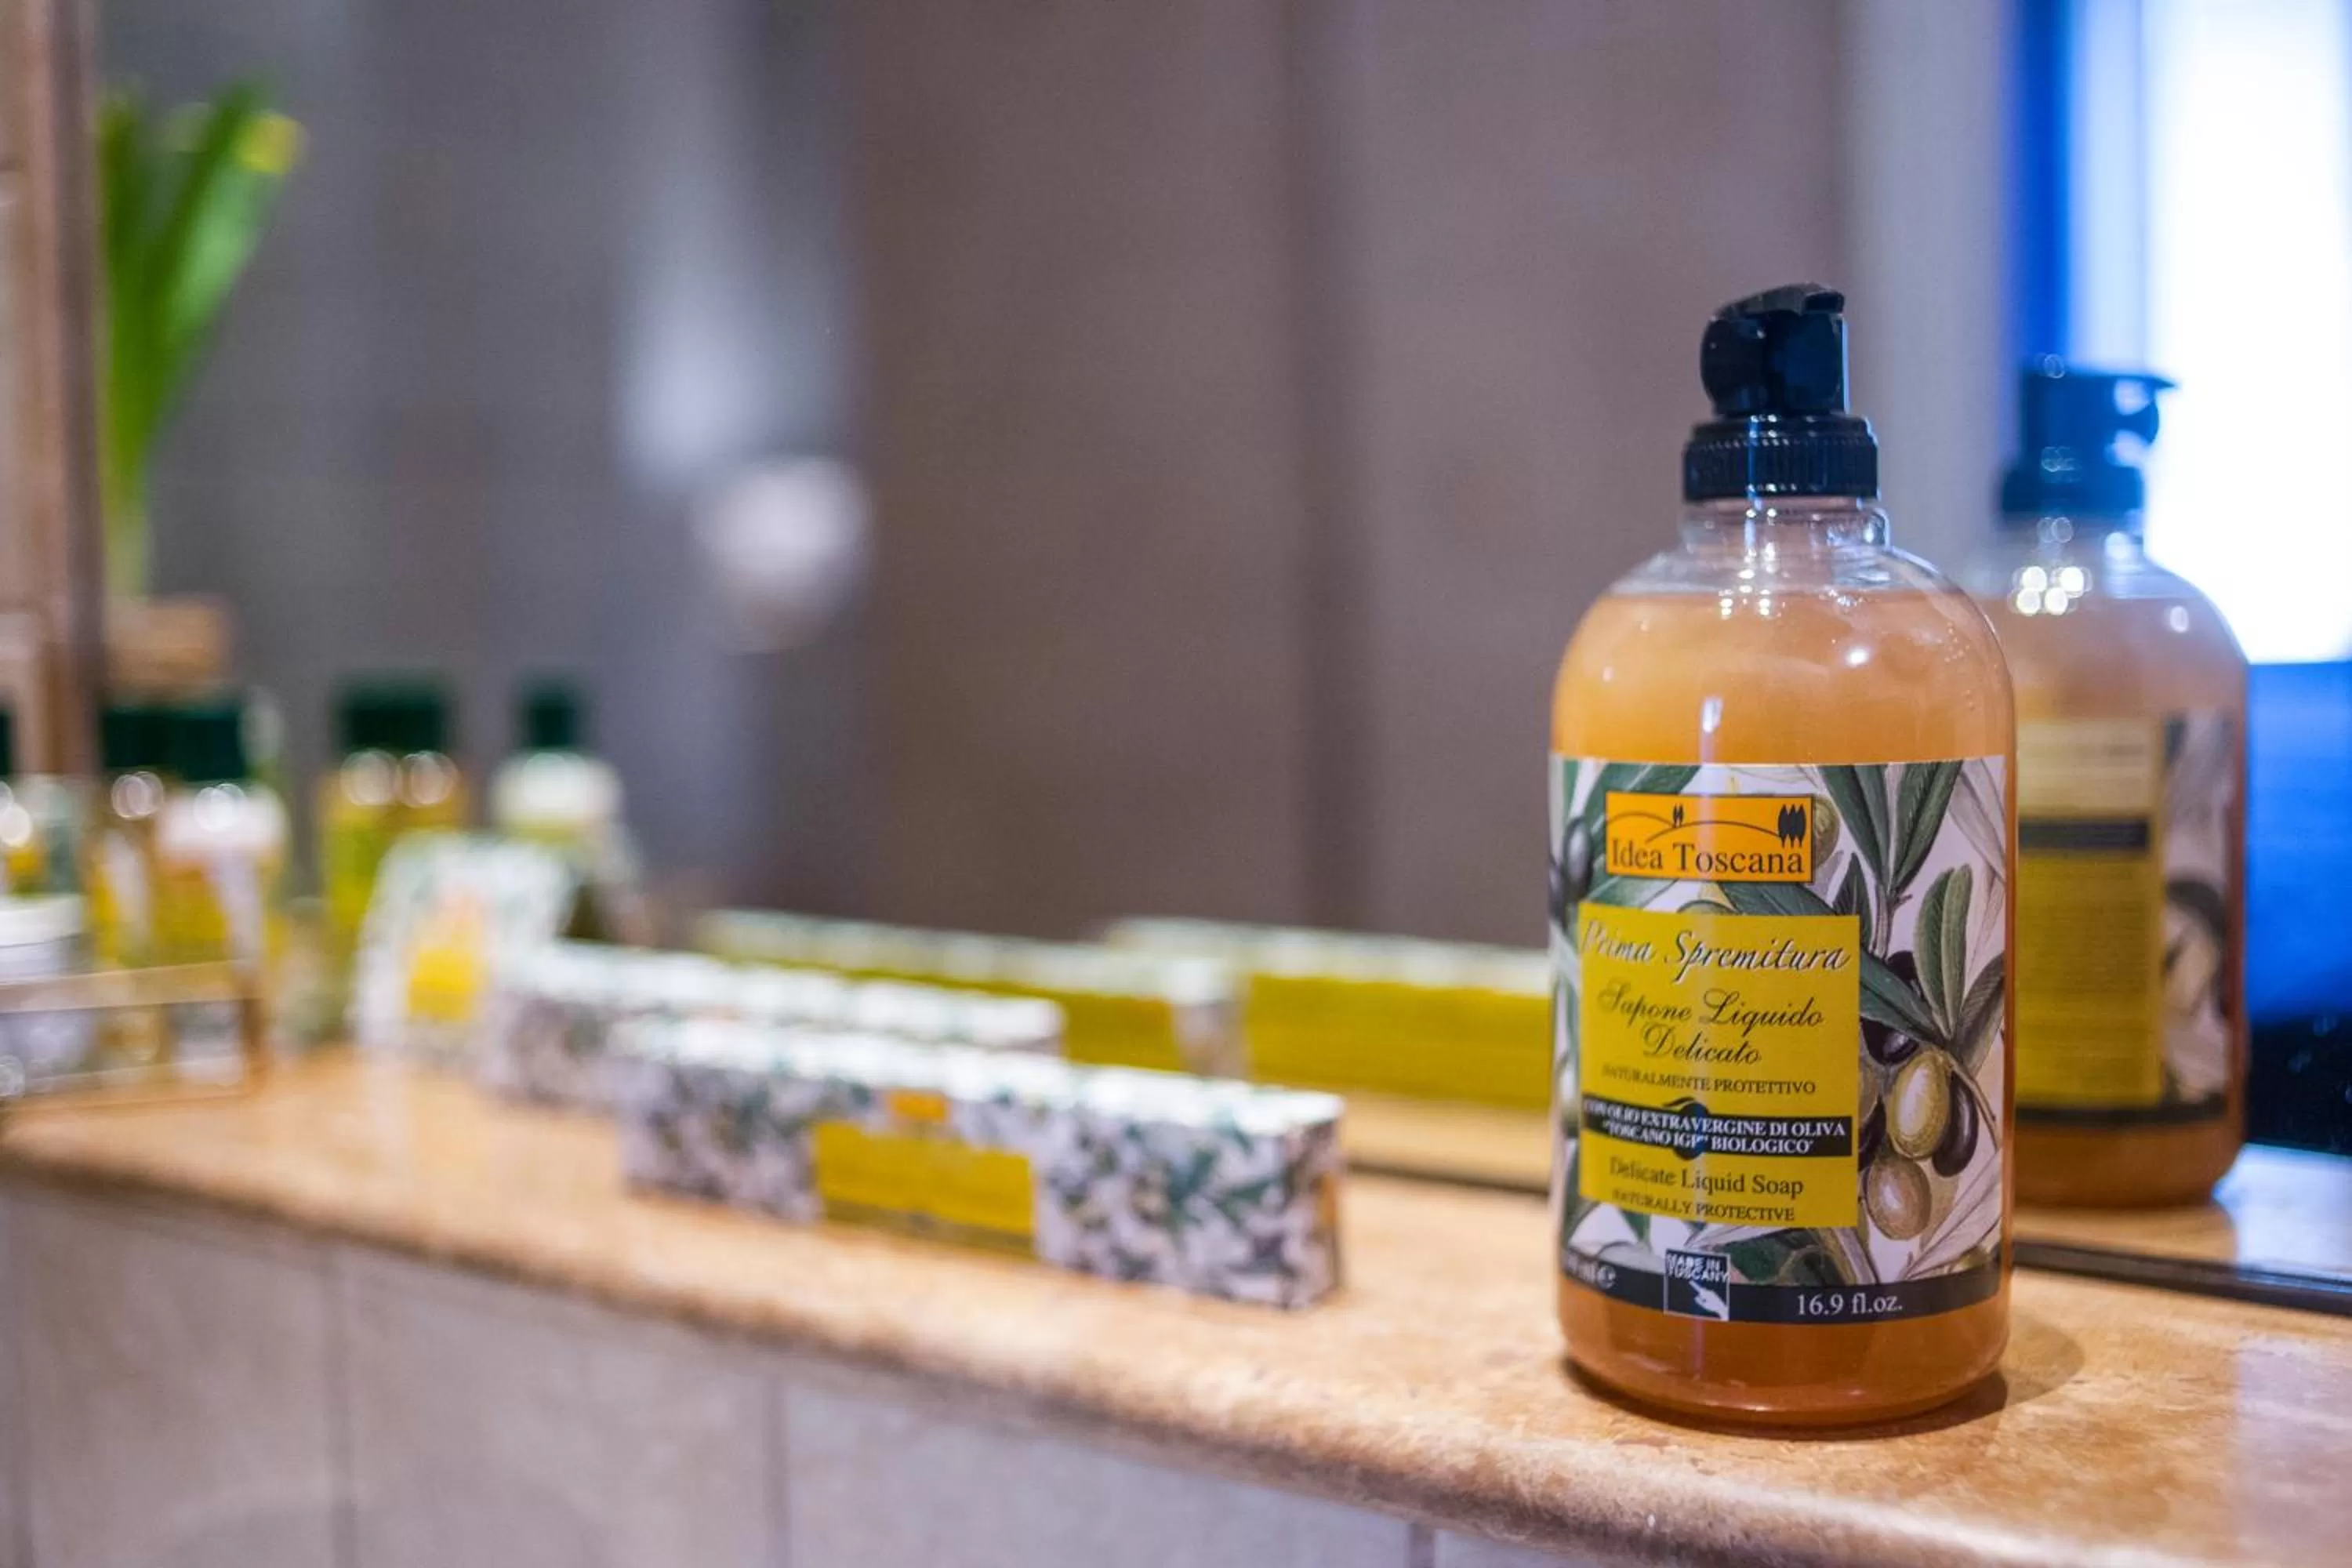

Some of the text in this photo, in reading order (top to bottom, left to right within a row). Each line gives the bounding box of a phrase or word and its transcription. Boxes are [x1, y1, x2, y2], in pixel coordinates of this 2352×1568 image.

[1612, 839, 1805, 874] Idea Toscana
[1581, 918, 1849, 985] Prima Spremitura
[1598, 978, 1824, 1037] Sapone Liquido
[1641, 1021, 1762, 1065] Delicato
[1602, 1065, 1817, 1094] NATURALMENTE PROTETTIVO
[1607, 1105, 1640, 1123] OLIO
[1642, 1110, 1766, 1135] EXTRAVERGINE
[1769, 1121, 1788, 1136] DI
[1791, 1121, 1846, 1137] OLIVA
[1610, 1156, 1804, 1200] Delicate Liquid Soap
[1612, 1189, 1795, 1221] NATURALLY PROTECTIVE
[1666, 1253, 1721, 1271] MADE IN
[1667, 1264, 1730, 1283] TUSCANY
[1797, 1293, 1844, 1316] 16.9
